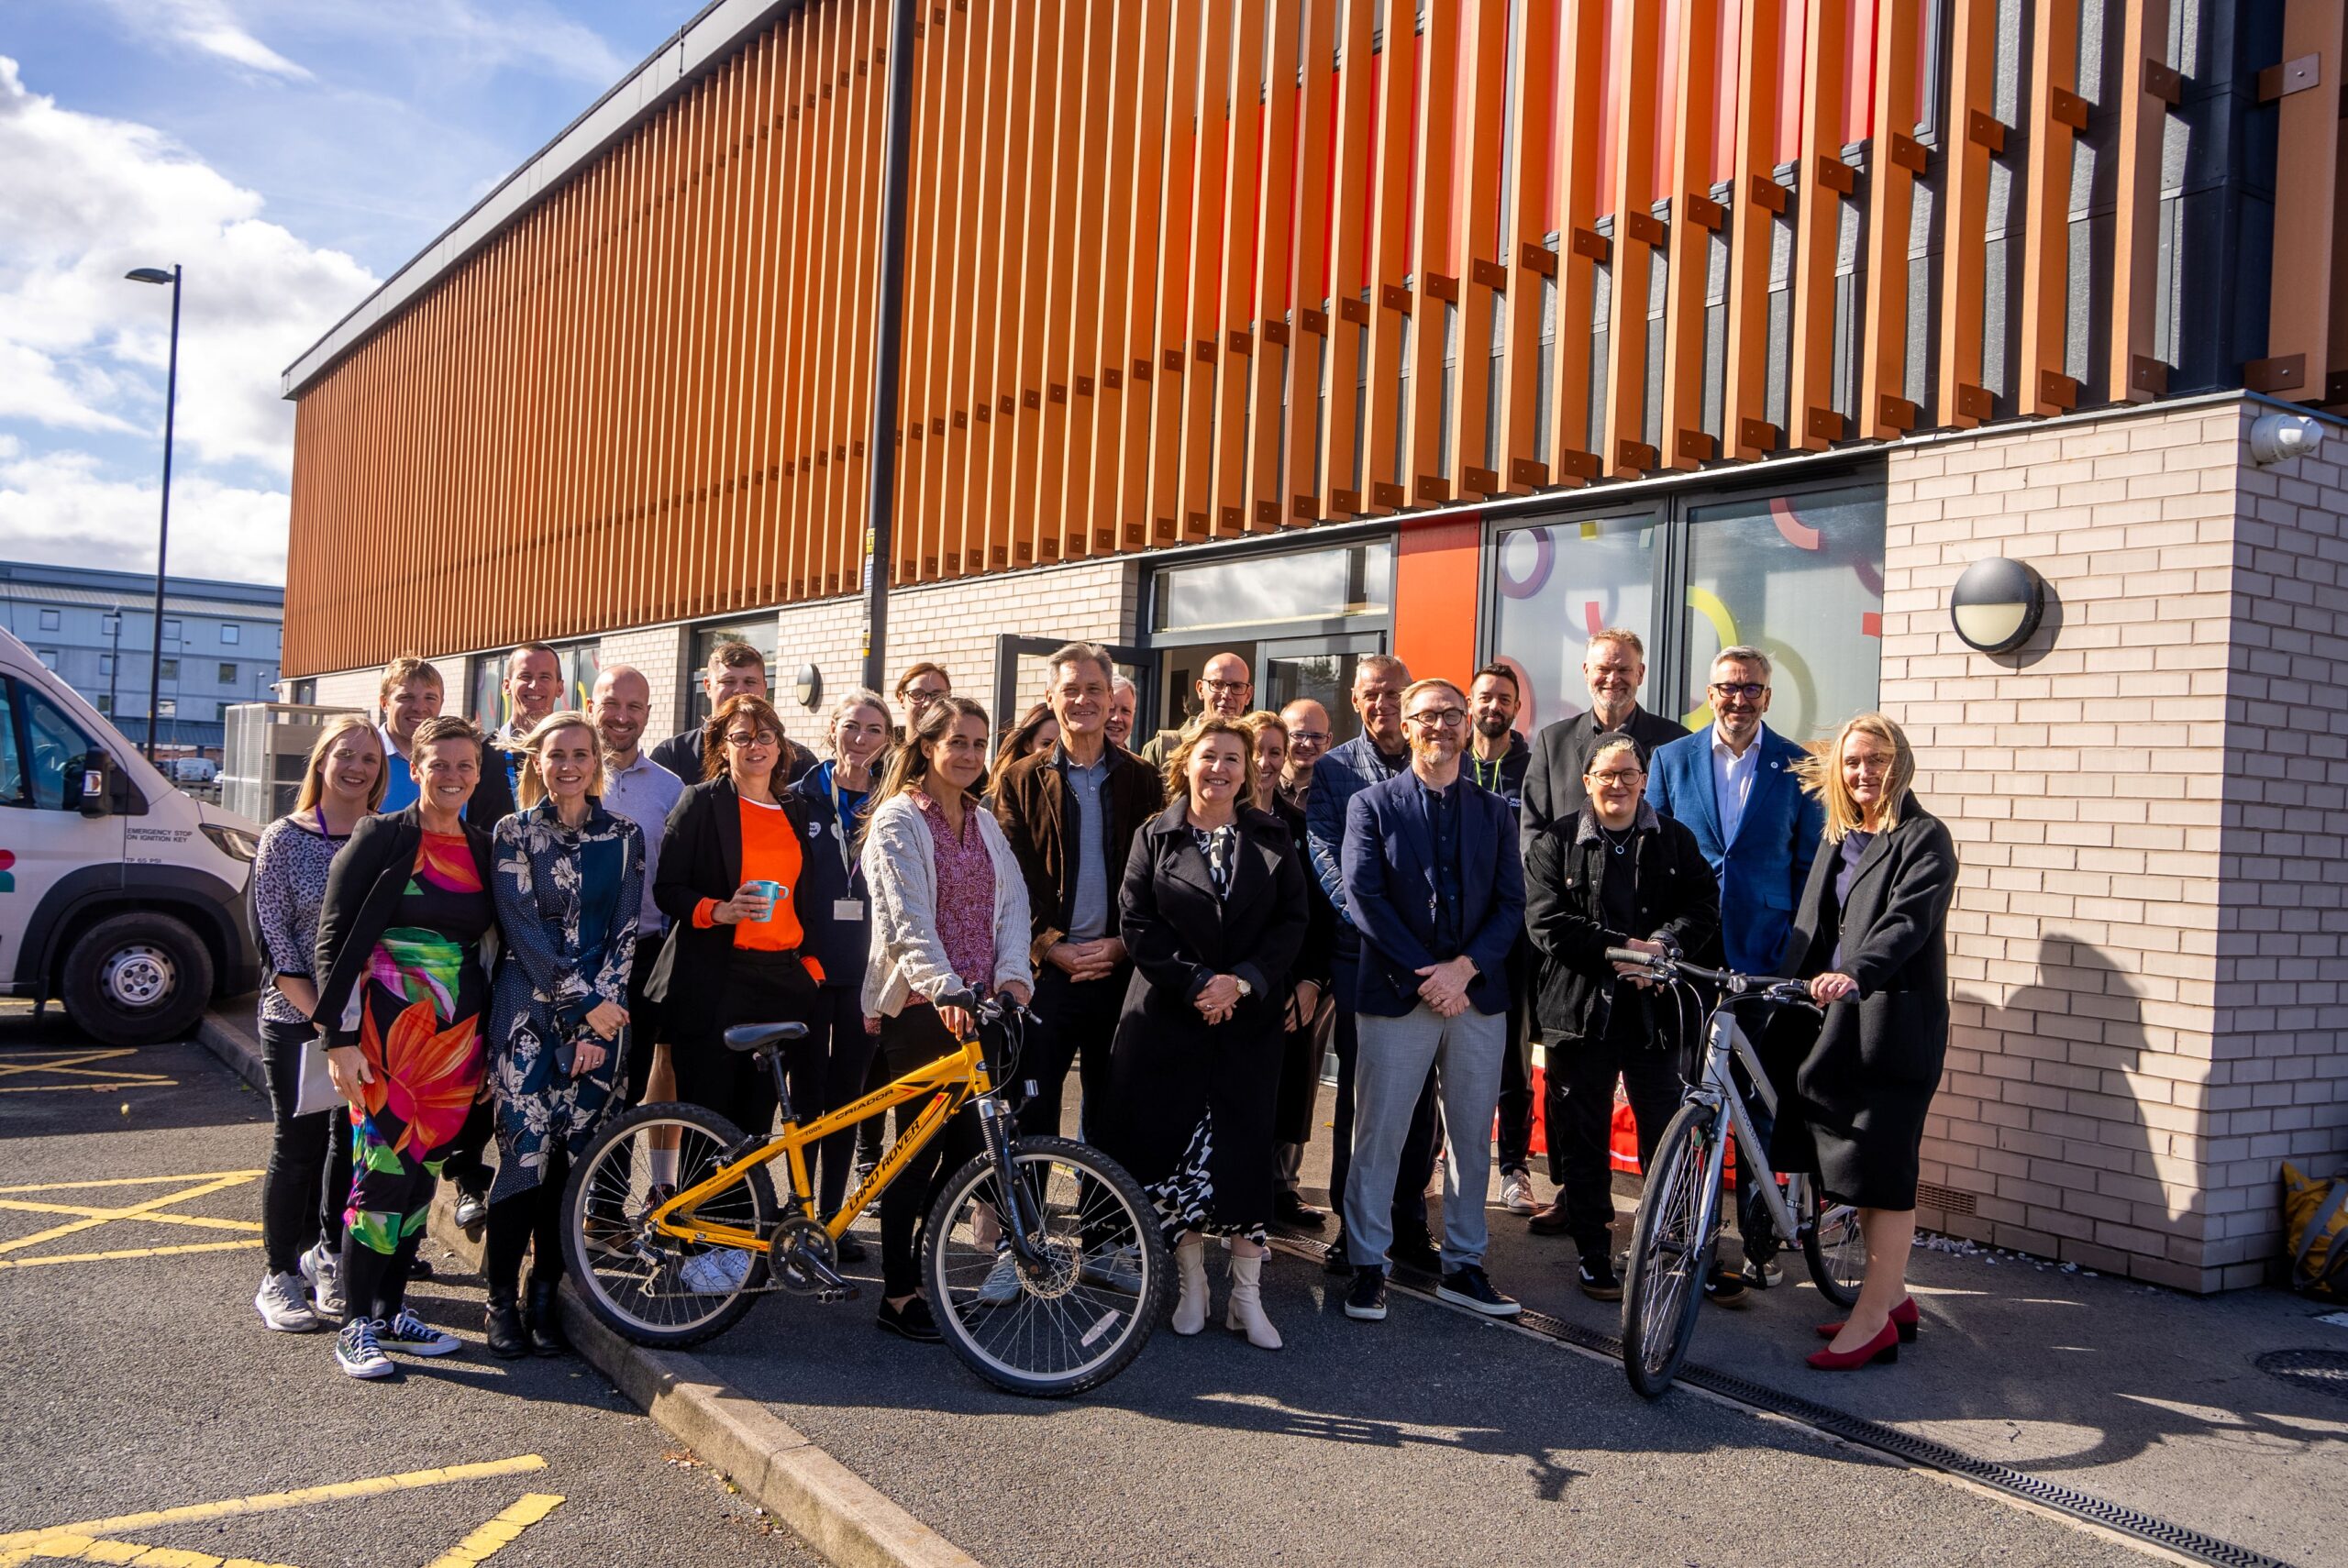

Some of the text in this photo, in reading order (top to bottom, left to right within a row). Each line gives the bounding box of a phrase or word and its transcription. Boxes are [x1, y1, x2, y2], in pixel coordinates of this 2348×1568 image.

[835, 1088, 894, 1121] CRIADOR
[849, 1120, 920, 1212] LAND ROVER
